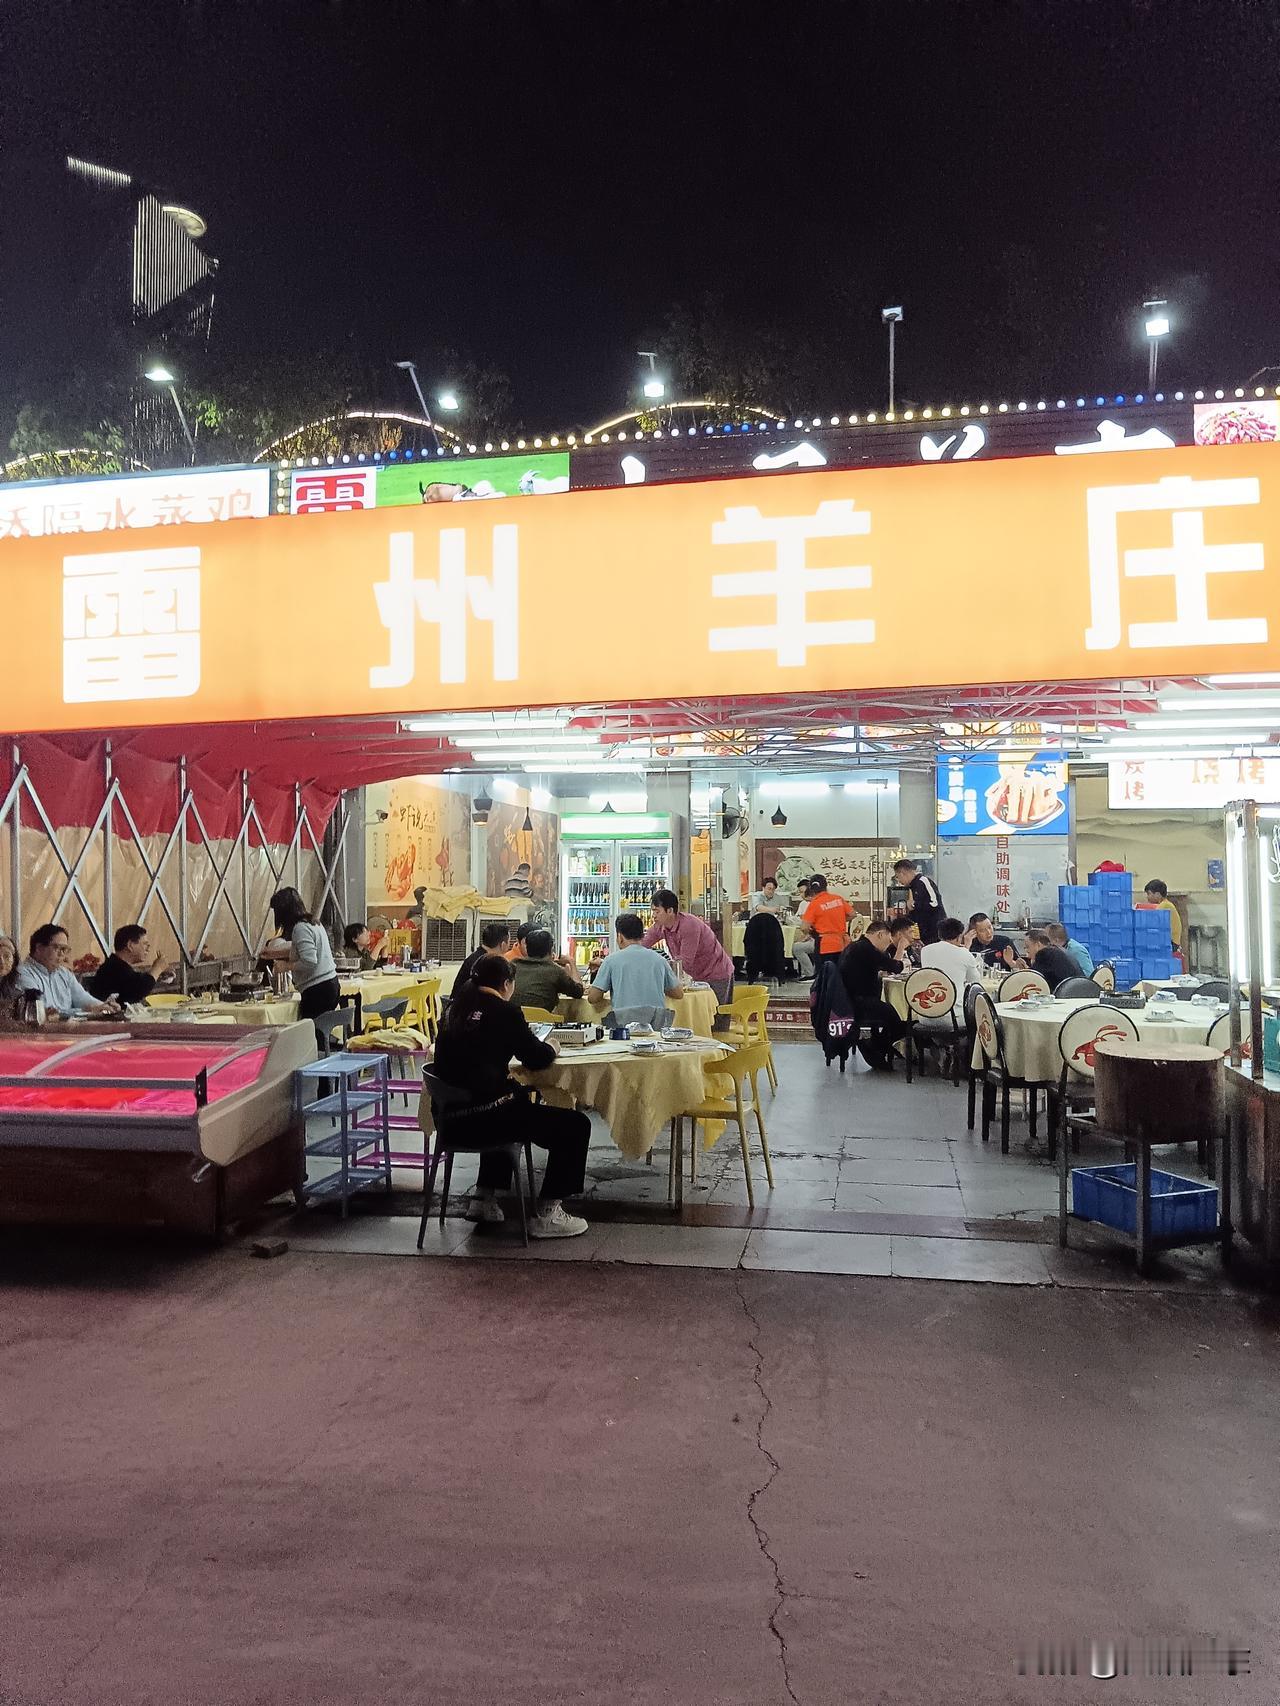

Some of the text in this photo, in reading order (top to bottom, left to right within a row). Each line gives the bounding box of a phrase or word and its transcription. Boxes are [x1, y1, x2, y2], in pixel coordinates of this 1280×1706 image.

[62, 475, 1269, 704] 雷州羊庄
[996, 837, 1011, 915] 自助调味处
